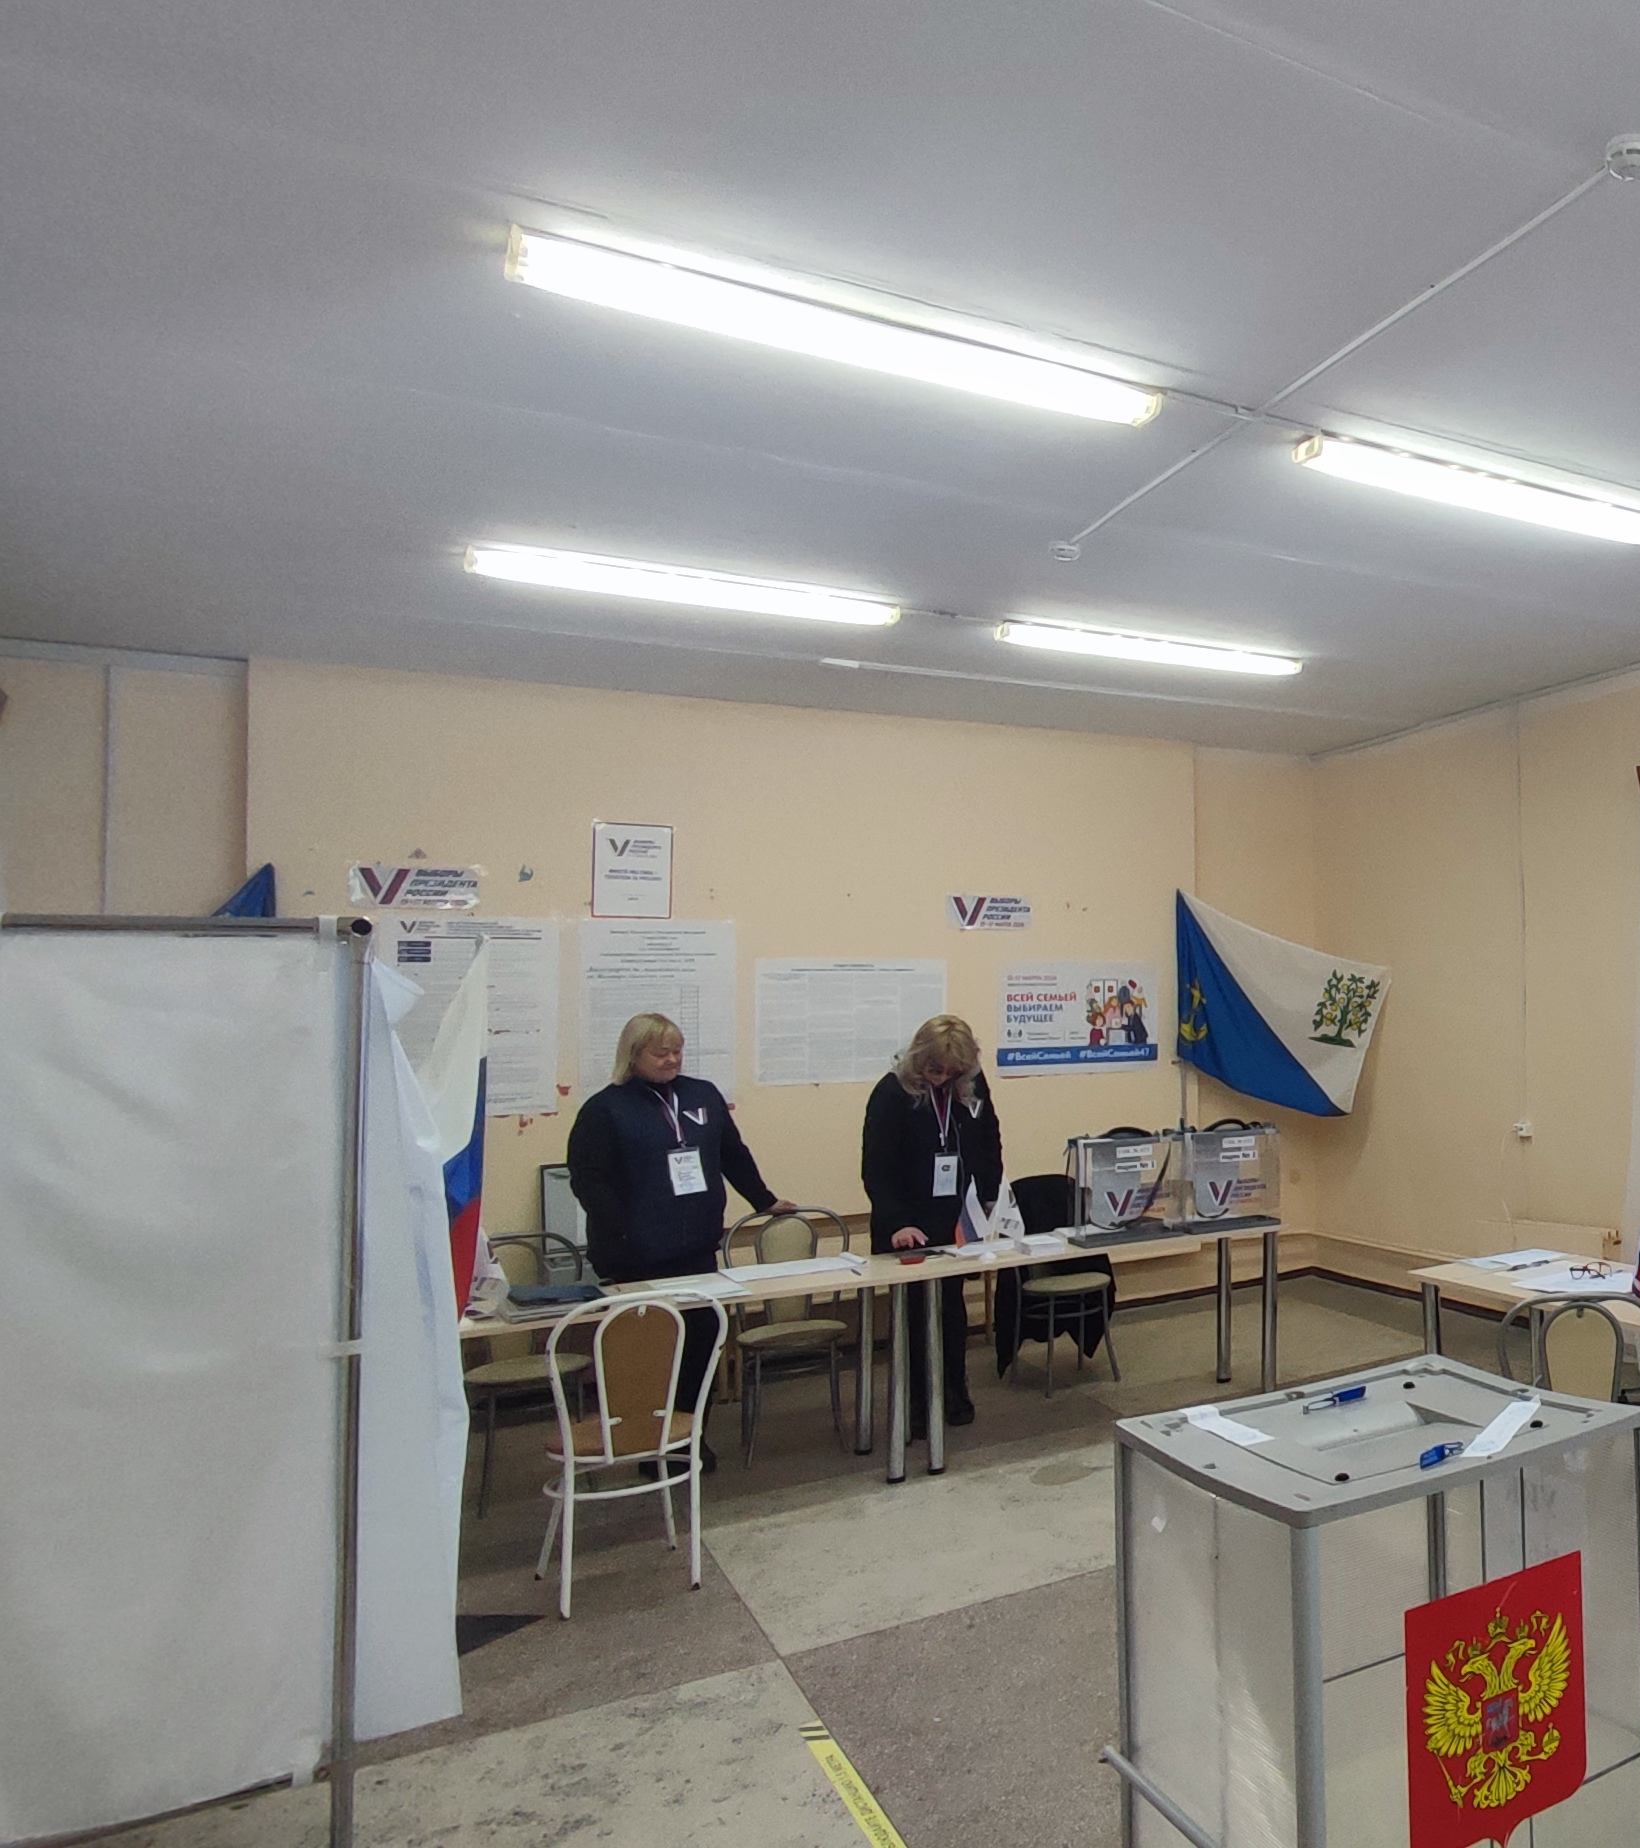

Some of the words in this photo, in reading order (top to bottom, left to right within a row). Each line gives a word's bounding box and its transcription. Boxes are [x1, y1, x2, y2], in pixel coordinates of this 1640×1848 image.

[1006, 992, 1034, 1002] ВСЕЙ
[1036, 992, 1077, 1002] СЕМЬЕЙ
[1006, 1003, 1064, 1013] ВЫБИРАЕМ
[1006, 1014, 1054, 1025] БУДУЩЕЕ
